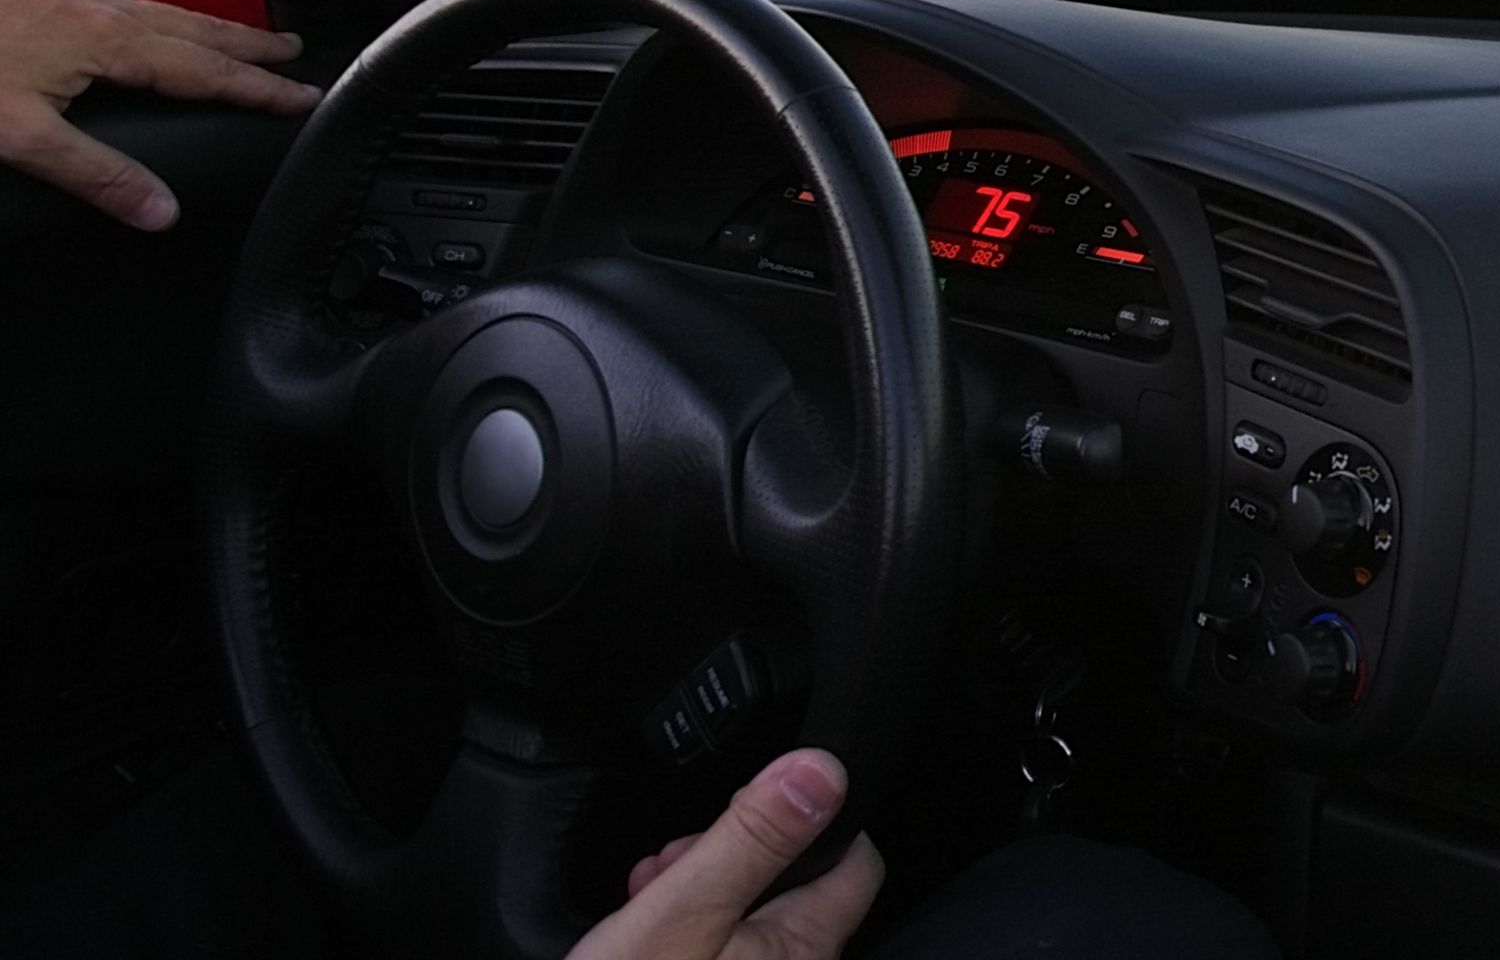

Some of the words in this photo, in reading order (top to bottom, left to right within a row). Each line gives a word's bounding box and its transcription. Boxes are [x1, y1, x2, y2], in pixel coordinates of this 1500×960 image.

[908, 165, 923, 177] 3
[937, 162, 950, 173] 4
[964, 161, 979, 173] 5
[995, 165, 1009, 176] 6
[1031, 174, 1045, 186] 7
[1065, 193, 1080, 206] 8
[972, 186, 1032, 239] 75
[1028, 223, 1056, 236] mph
[1102, 225, 1118, 239] 9
[1075, 242, 1089, 255] E
[971, 249, 1005, 268] 88.2
[1229, 497, 1257, 520] A/C
